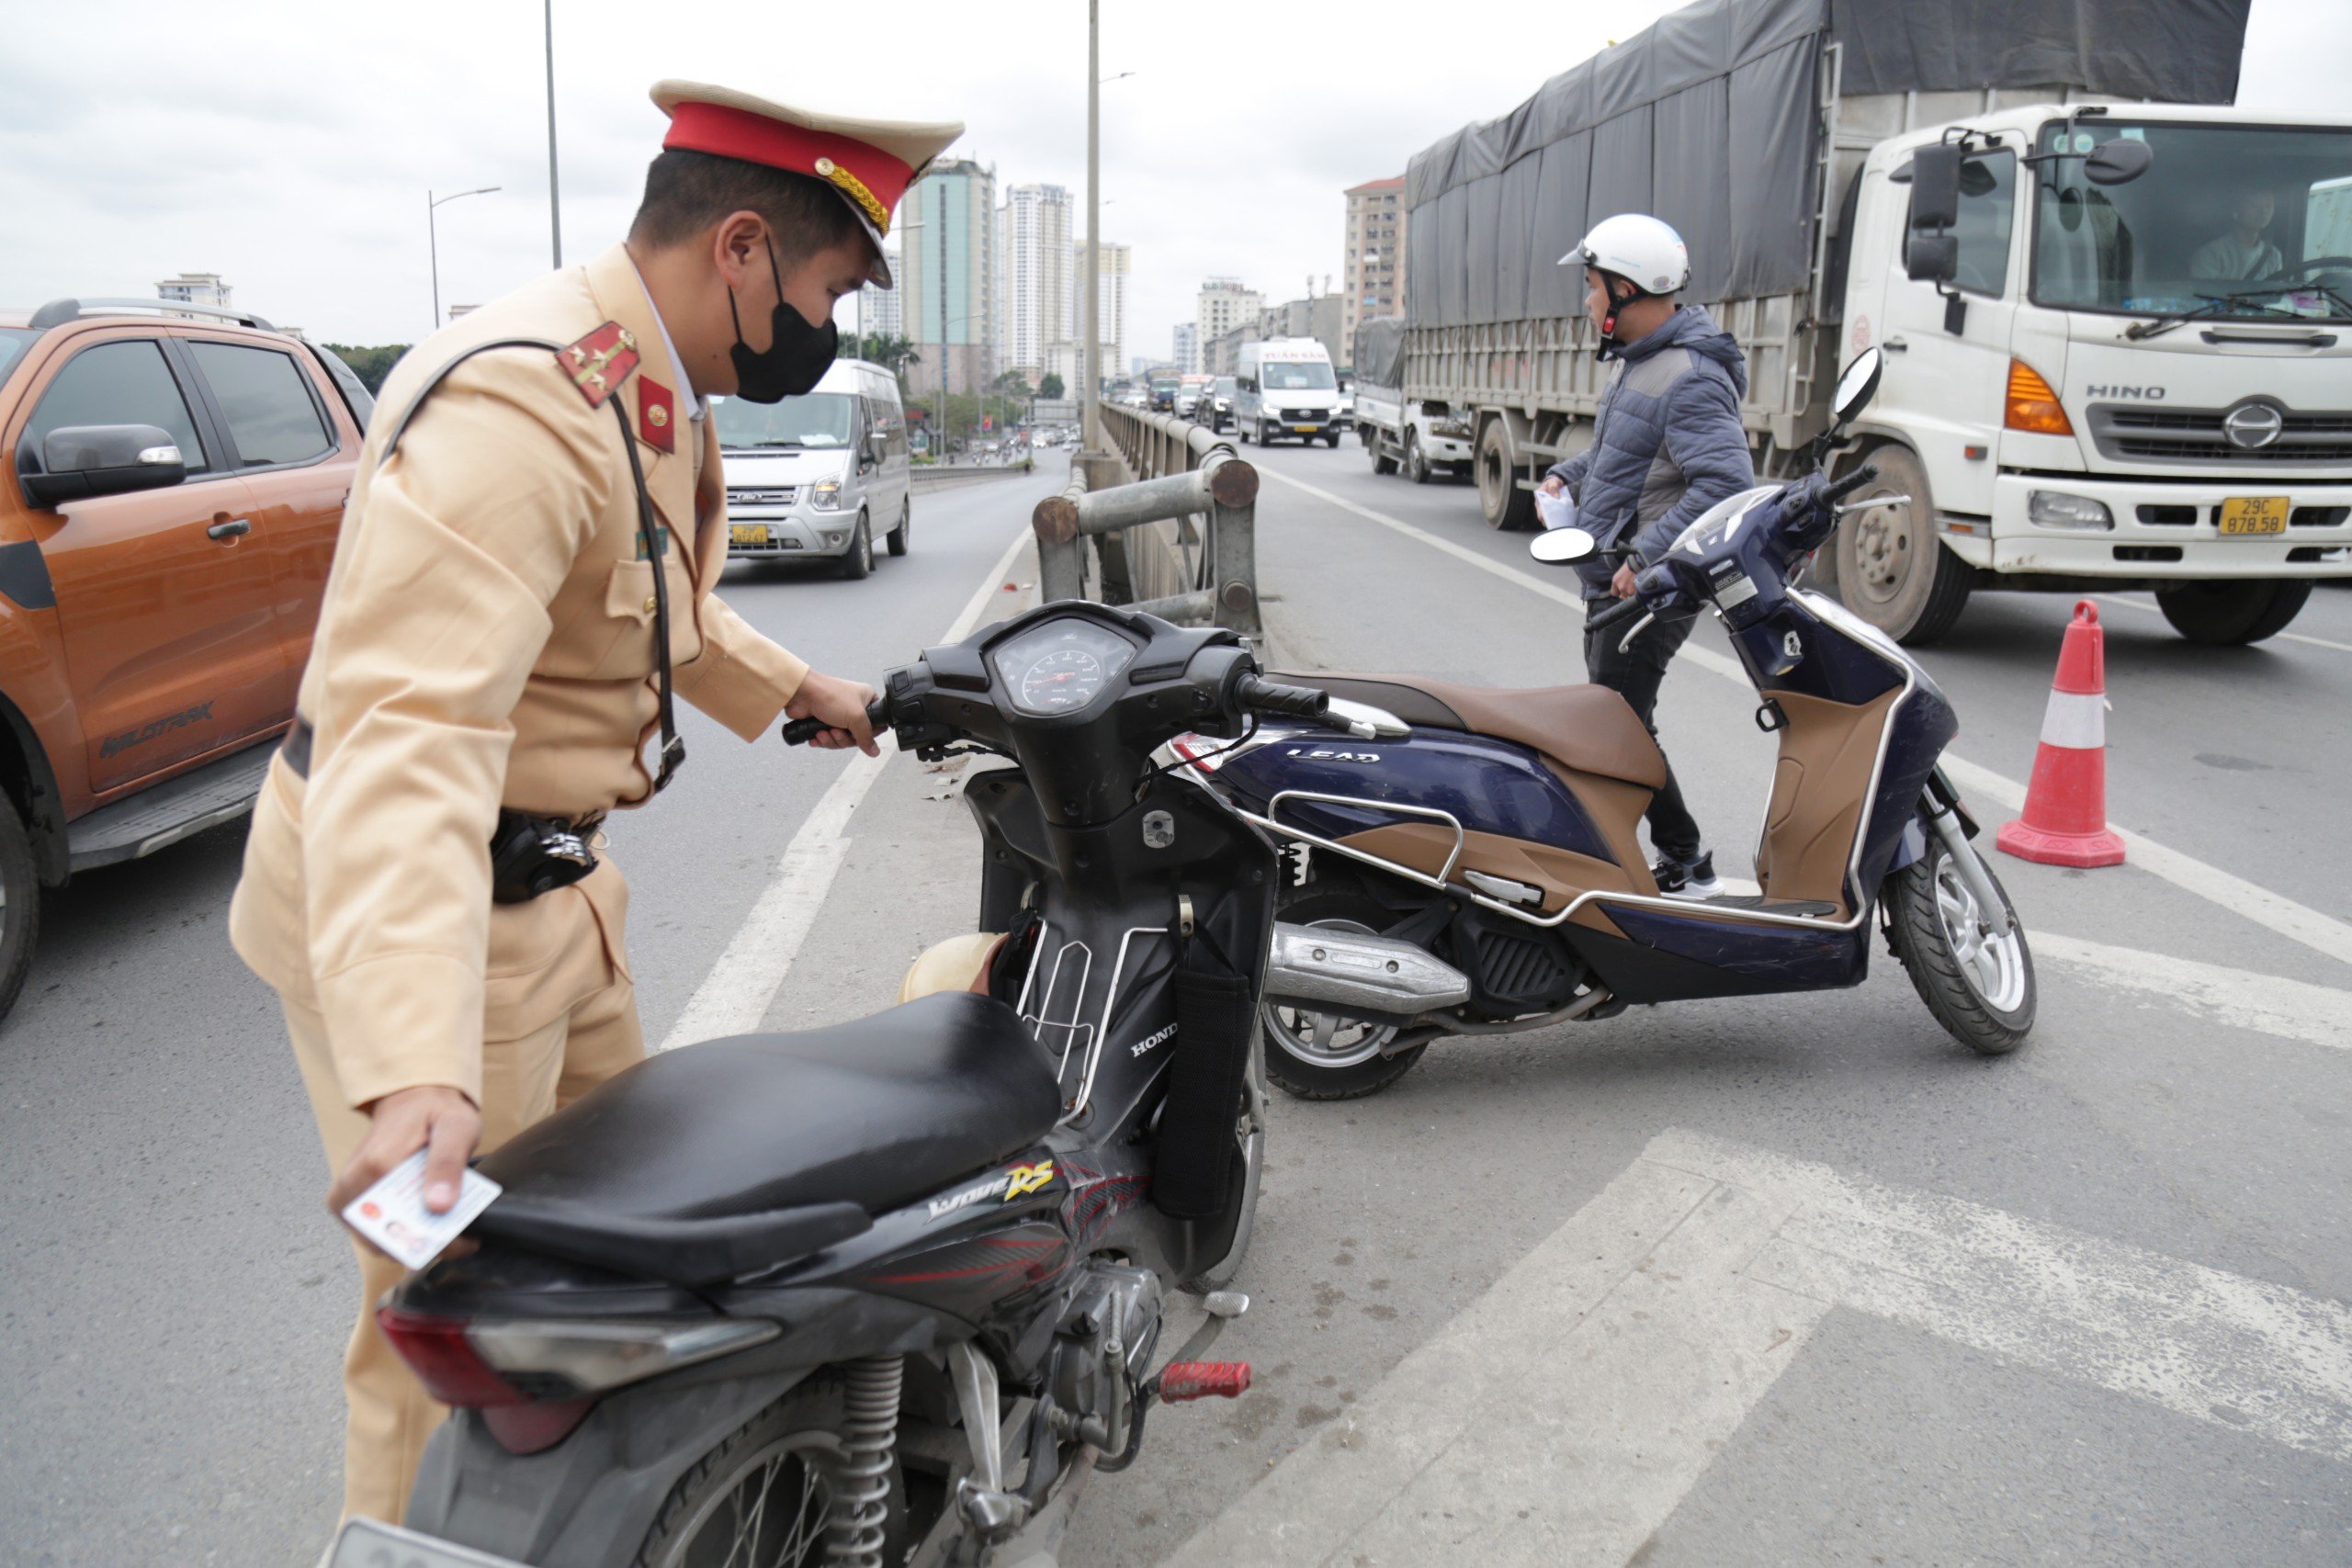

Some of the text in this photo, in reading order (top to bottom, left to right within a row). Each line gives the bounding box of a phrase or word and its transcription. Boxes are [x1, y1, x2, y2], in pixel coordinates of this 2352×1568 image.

[2086, 385, 2165, 400] HINO
[2242, 500, 2269, 514] 29C
[2227, 516, 2279, 532] 878.58
[1286, 749, 1381, 764] LEAD
[1130, 1022, 1178, 1058] HOND
[1004, 1159, 1054, 1202] RS
